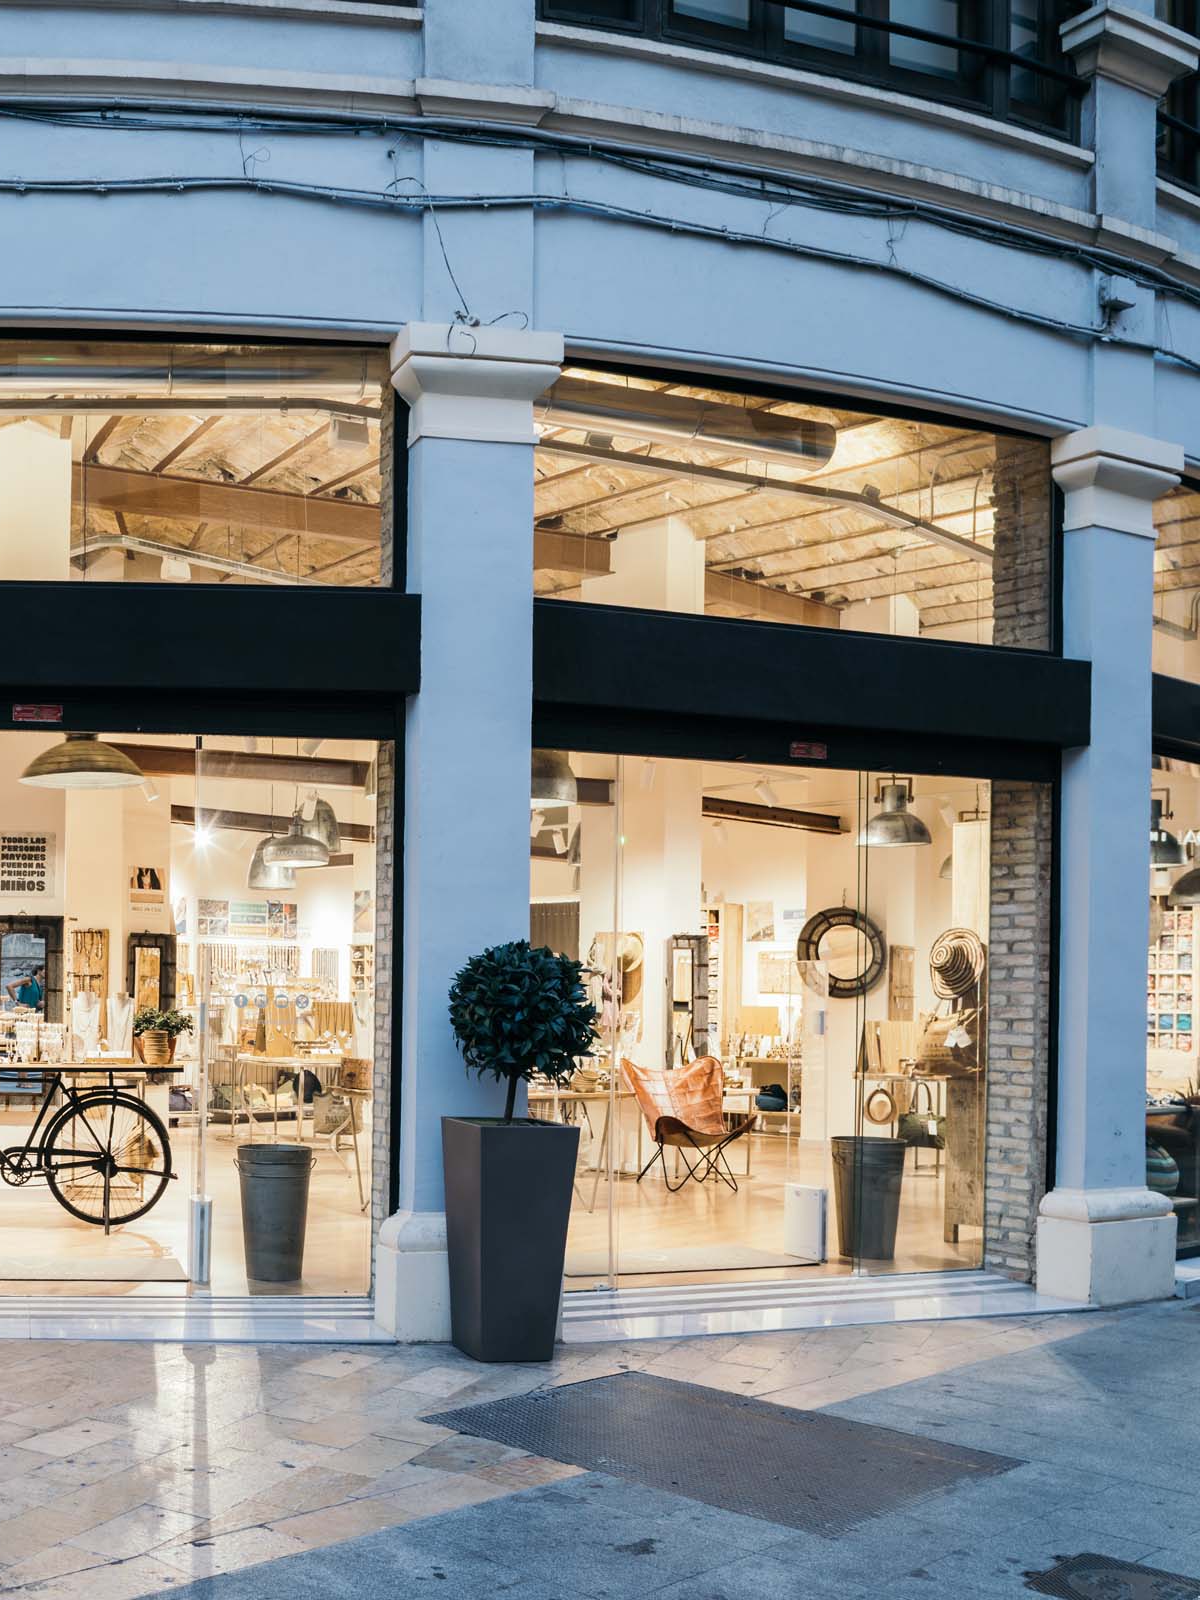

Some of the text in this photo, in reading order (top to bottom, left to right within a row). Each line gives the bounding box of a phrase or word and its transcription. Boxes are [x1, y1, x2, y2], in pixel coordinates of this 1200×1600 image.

[1, 836, 29, 844] TODAS
[1, 853, 47, 861] MAYORES
[0, 877, 46, 892] NIÑOS
